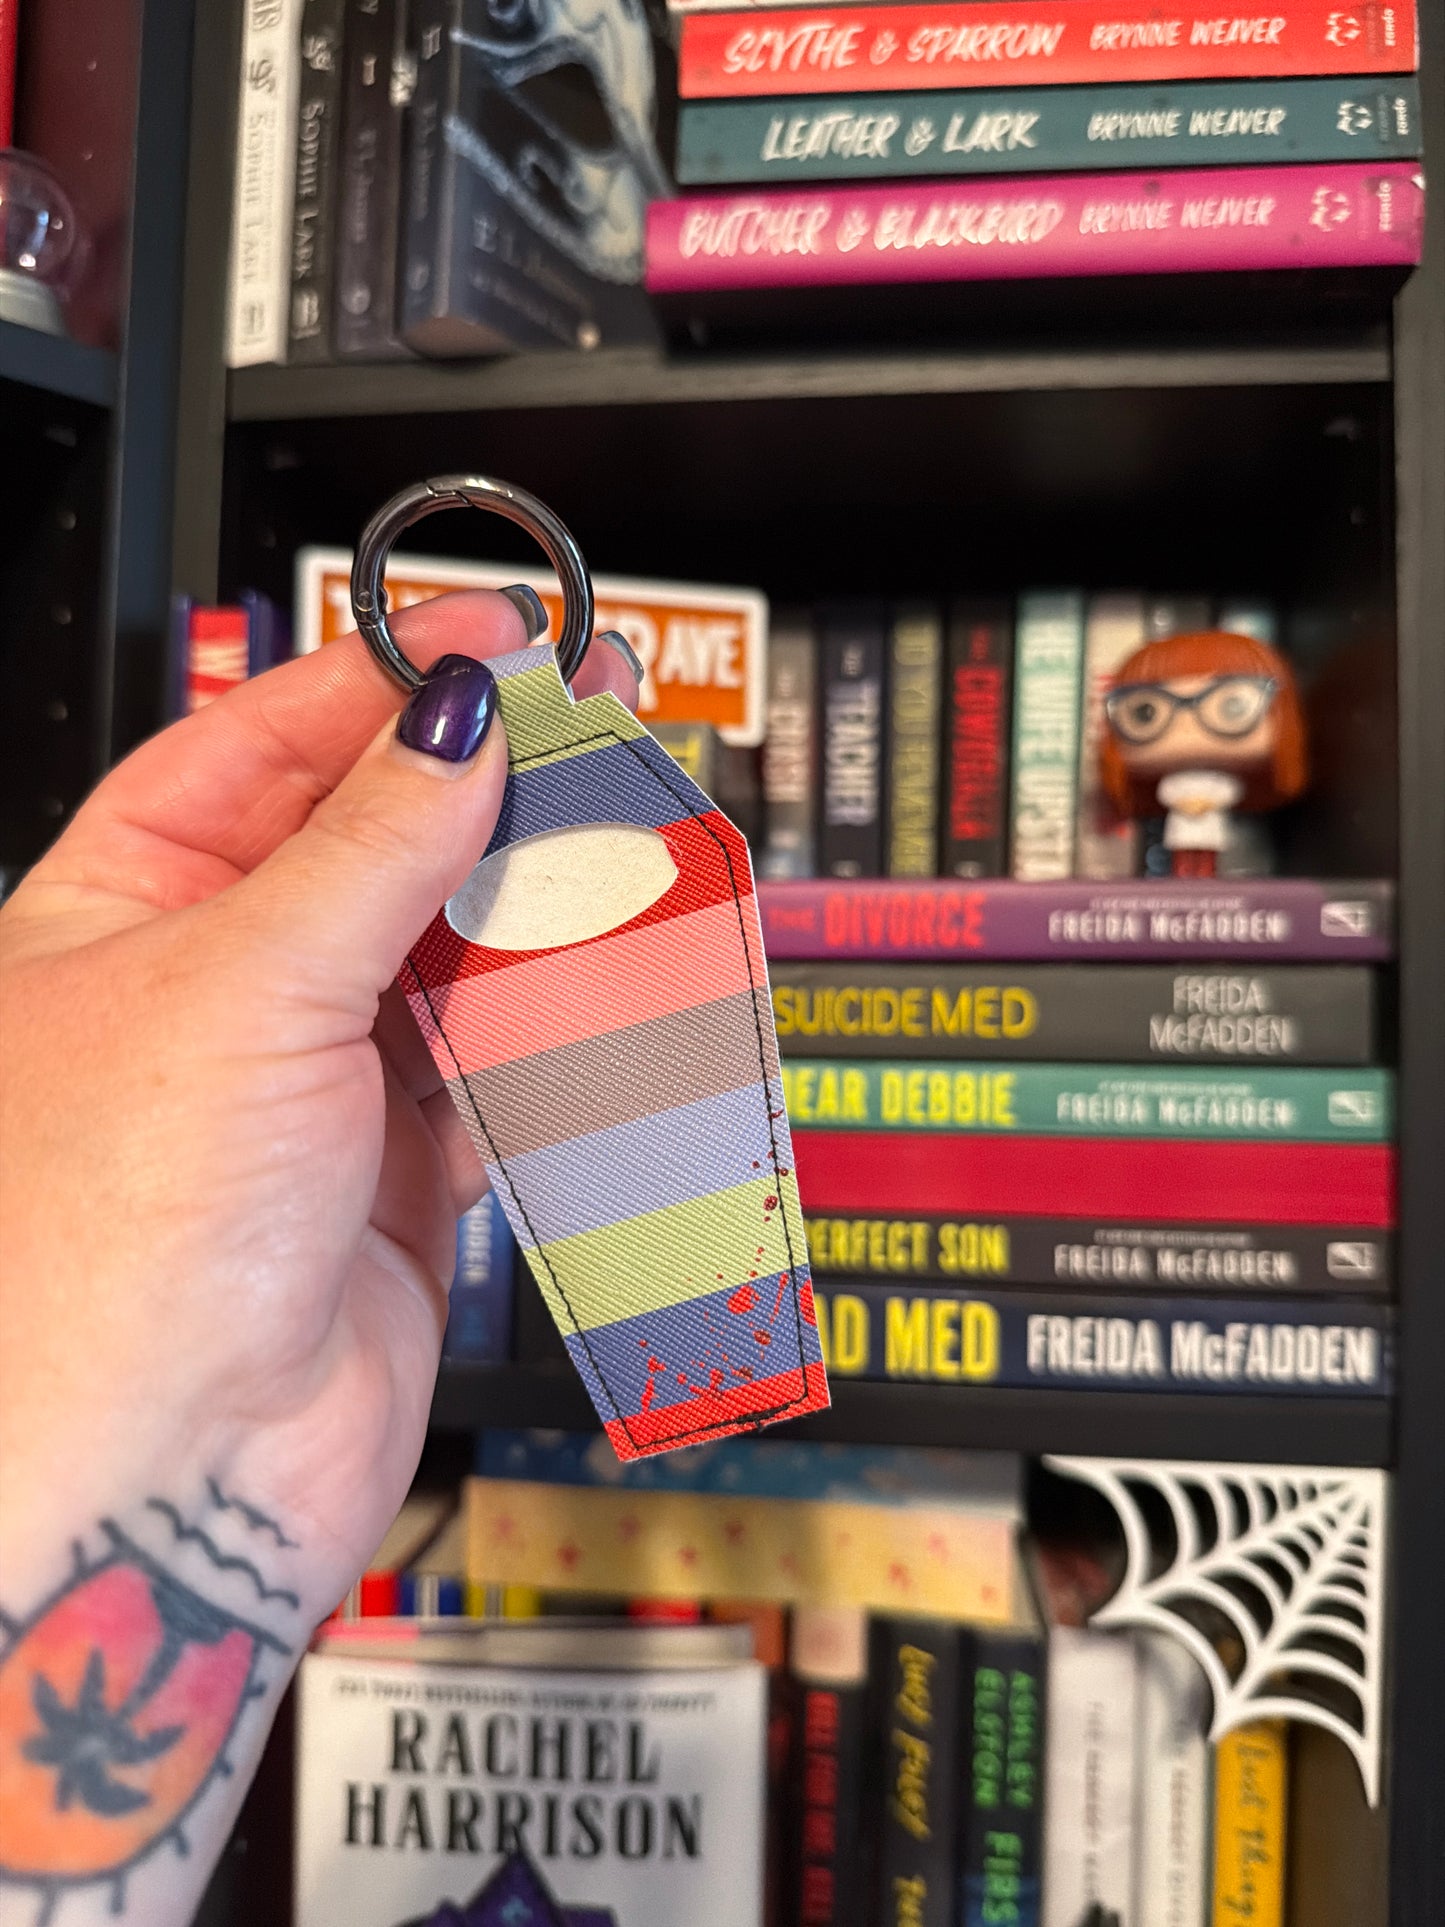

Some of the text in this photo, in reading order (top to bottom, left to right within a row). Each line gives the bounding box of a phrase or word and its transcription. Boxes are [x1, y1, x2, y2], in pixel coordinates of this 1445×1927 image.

[723, 20, 1066, 74] SCYTHE & SPARROW
[1090, 17, 1286, 50] BRYNNE WEAVER
[762, 107, 1041, 161] LEATHER & LARK
[1088, 107, 1286, 140] BRYNNE WEAVER
[679, 200, 1063, 259] BUTCHER & BLACKBIRD
[1079, 197, 1276, 234] BRYNNE WEAVER
[825, 680, 879, 826] TEACHER
[825, 891, 986, 948] DIVORCE
[1048, 909, 1290, 943] FREIDA McFADDEN
[772, 986, 1037, 1040] SUICIDE MED
[1174, 976, 1268, 1015] FREIDA
[1150, 1014, 1296, 1054] McFADDEN
[881, 1069, 1016, 1127] DEBBIE
[1057, 1092, 1296, 1129] FREIDA McFADDEN
[805, 1218, 1010, 1276] ERFECT SON
[1054, 1244, 1299, 1286] FREIDA McFADDEN
[885, 1297, 999, 1382] MED
[1027, 1313, 1380, 1386] FREIDA McFADDEN
[388, 1707, 661, 1786] RACHEL
[344, 1782, 703, 1860] HARRISON
